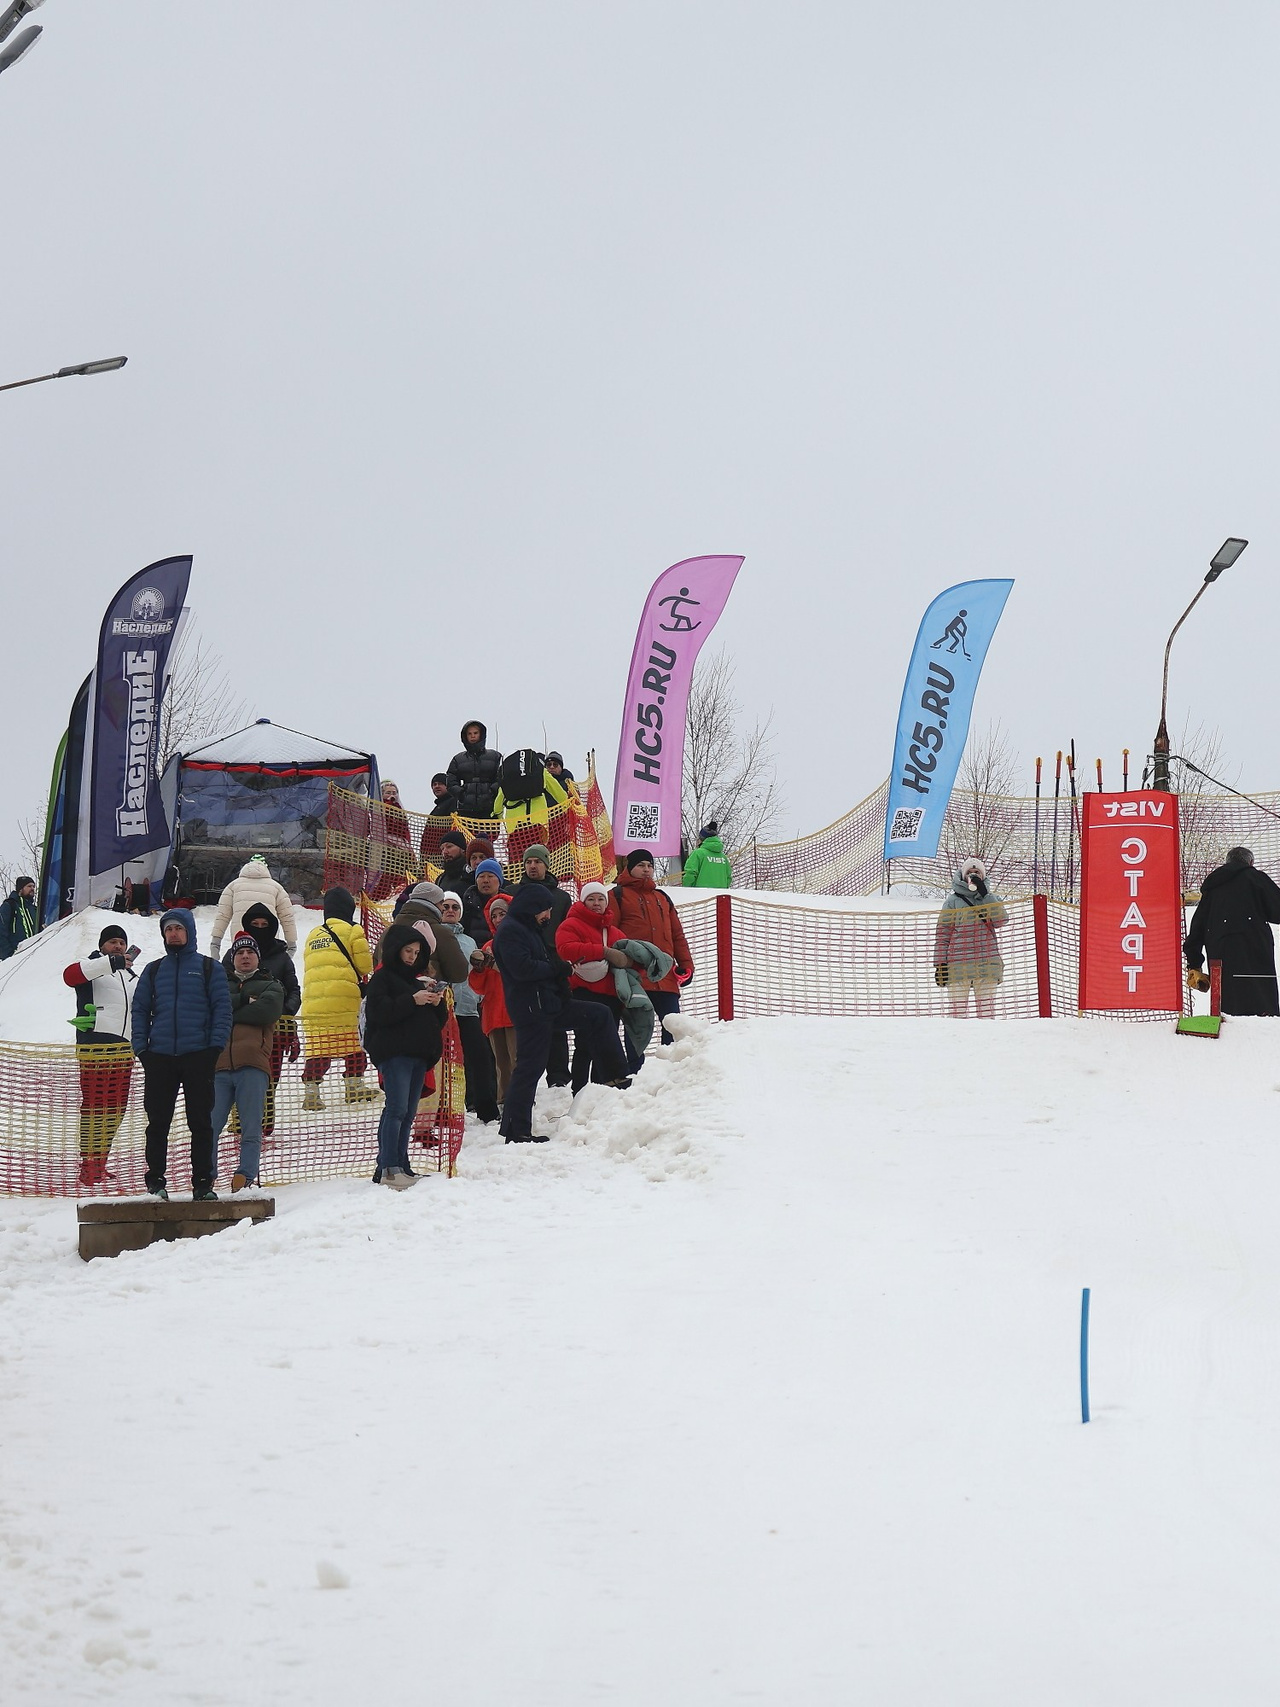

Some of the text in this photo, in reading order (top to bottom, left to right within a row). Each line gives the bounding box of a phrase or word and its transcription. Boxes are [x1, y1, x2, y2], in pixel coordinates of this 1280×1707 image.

[633, 640, 677, 785] HC5.RU
[902, 661, 955, 795] HC5.RU
[309, 937, 335, 947] WORLDCU
